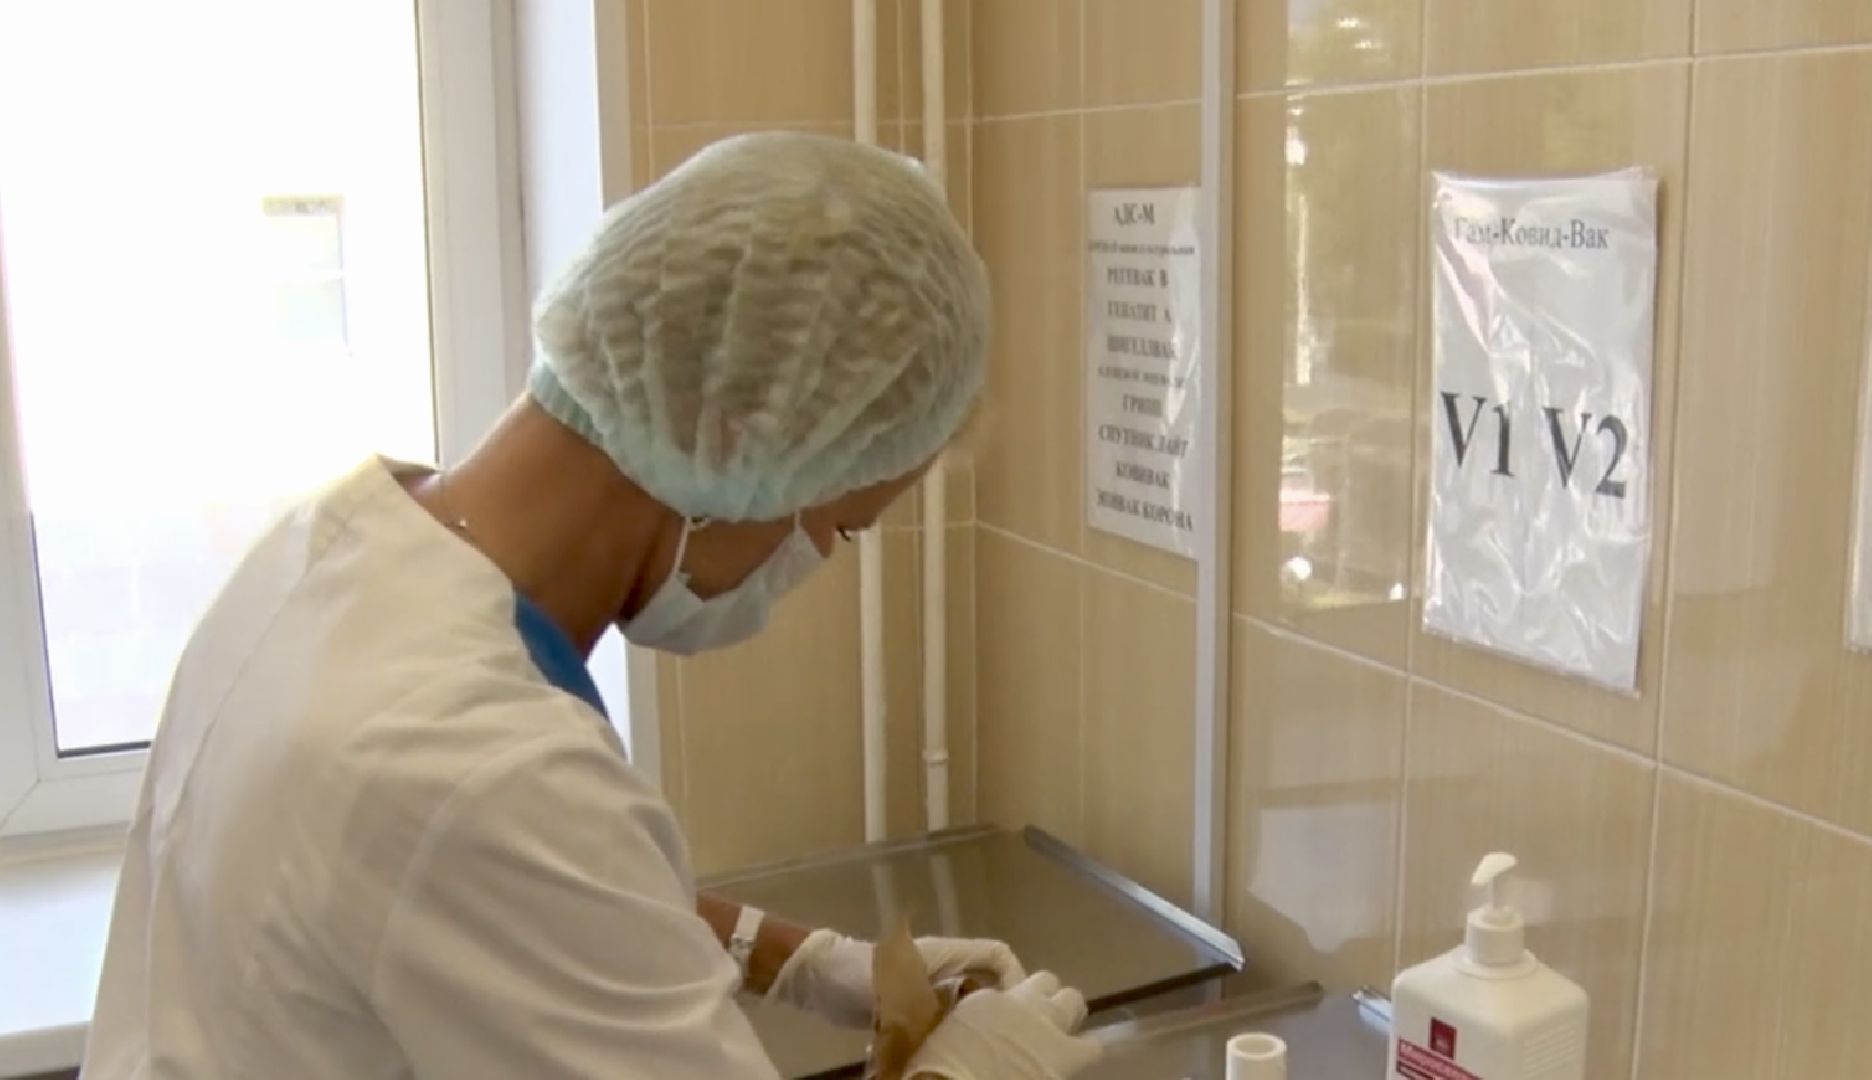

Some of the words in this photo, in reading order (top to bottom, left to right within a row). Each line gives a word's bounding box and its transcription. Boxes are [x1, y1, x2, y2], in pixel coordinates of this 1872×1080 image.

[1454, 216, 1608, 249] Гам-Ковид-Вак
[1440, 391, 1514, 477] V1
[1542, 406, 1627, 499] V2
